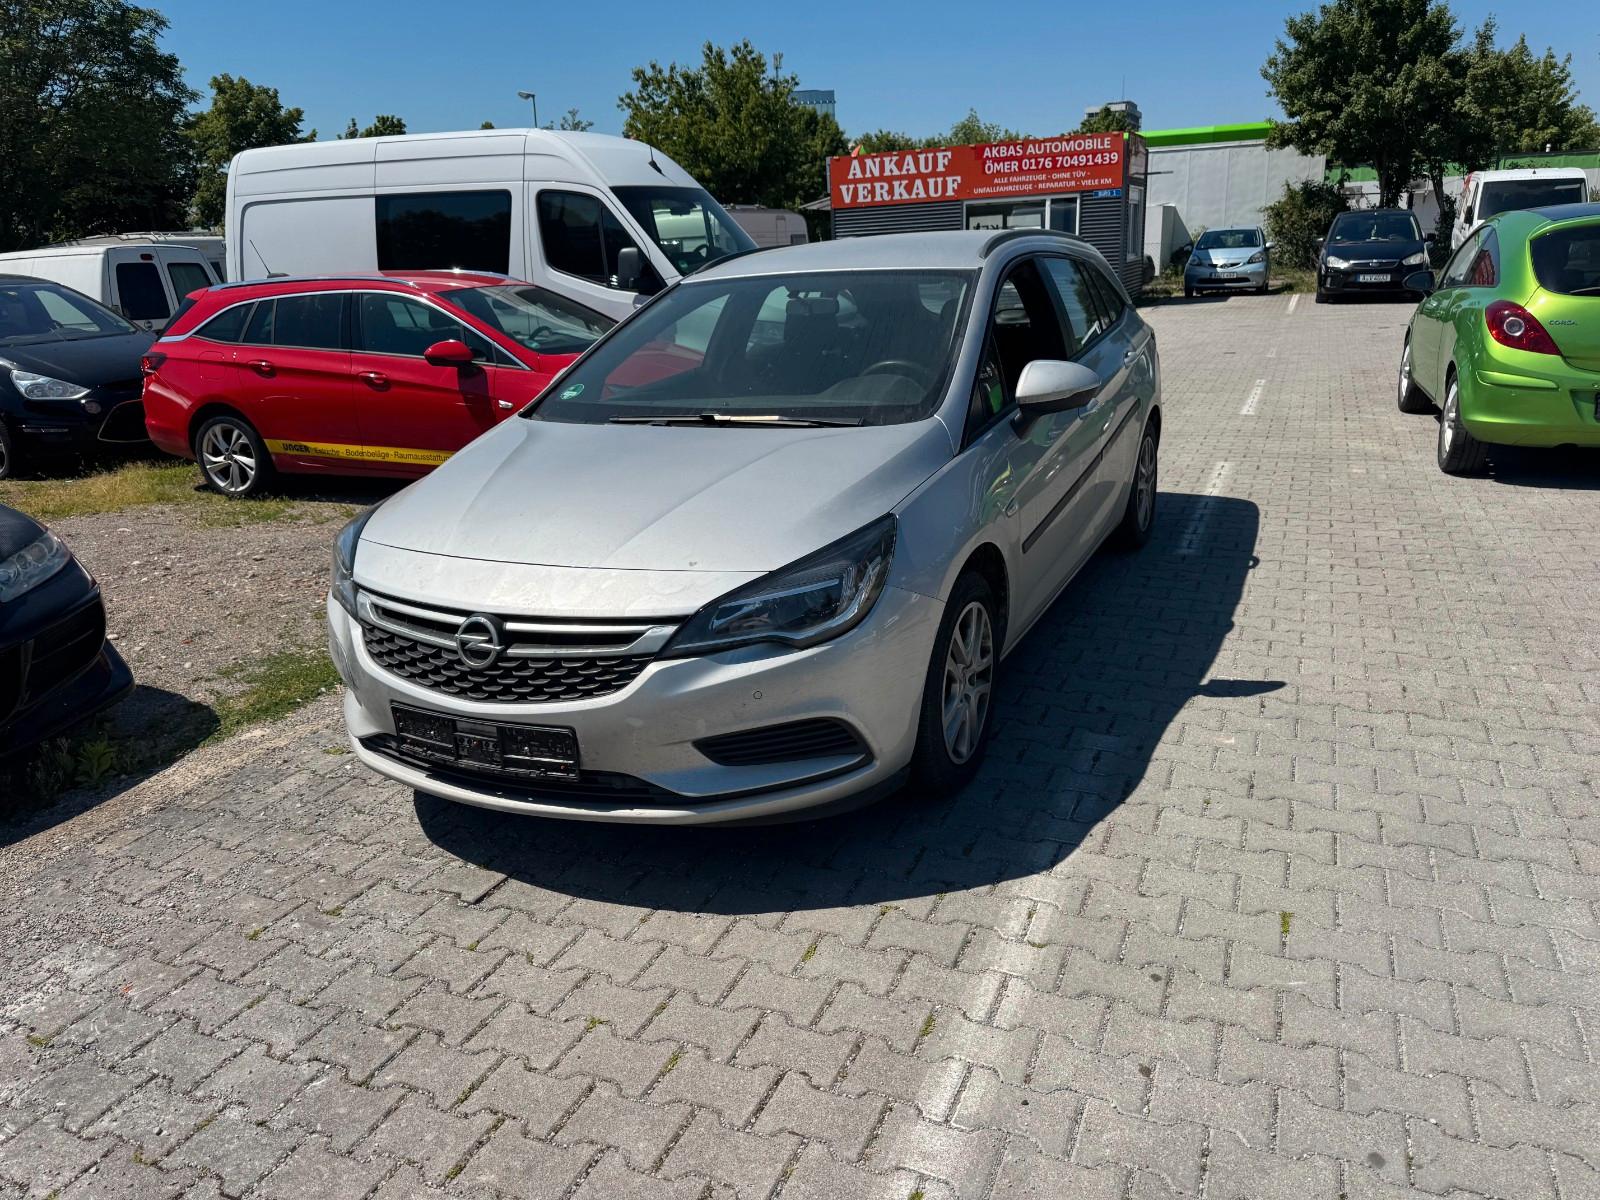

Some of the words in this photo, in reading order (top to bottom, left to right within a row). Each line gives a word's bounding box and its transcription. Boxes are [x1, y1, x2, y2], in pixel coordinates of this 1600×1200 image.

[983, 145, 1023, 158] AKBAS
[1026, 137, 1111, 155] AUTOMOBILE
[848, 151, 952, 179] ANKAUF
[985, 159, 1019, 175] ÖMER
[1022, 157, 1053, 170] 0176
[1056, 151, 1119, 168] 70491439
[973, 184, 1033, 194] UNFALLFAHRZEUGE
[1038, 181, 1076, 190] REPARATUR
[1081, 178, 1099, 186] VIELE
[993, 176, 1008, 184] ALLE
[1009, 174, 1047, 183] FAHRZEUGE
[1072, 170, 1086, 178] TÜV
[840, 176, 961, 204] VERKAUF
[345, 448, 390, 459] Bodenbeläge
[394, 451, 450, 462] Raumausstattun
